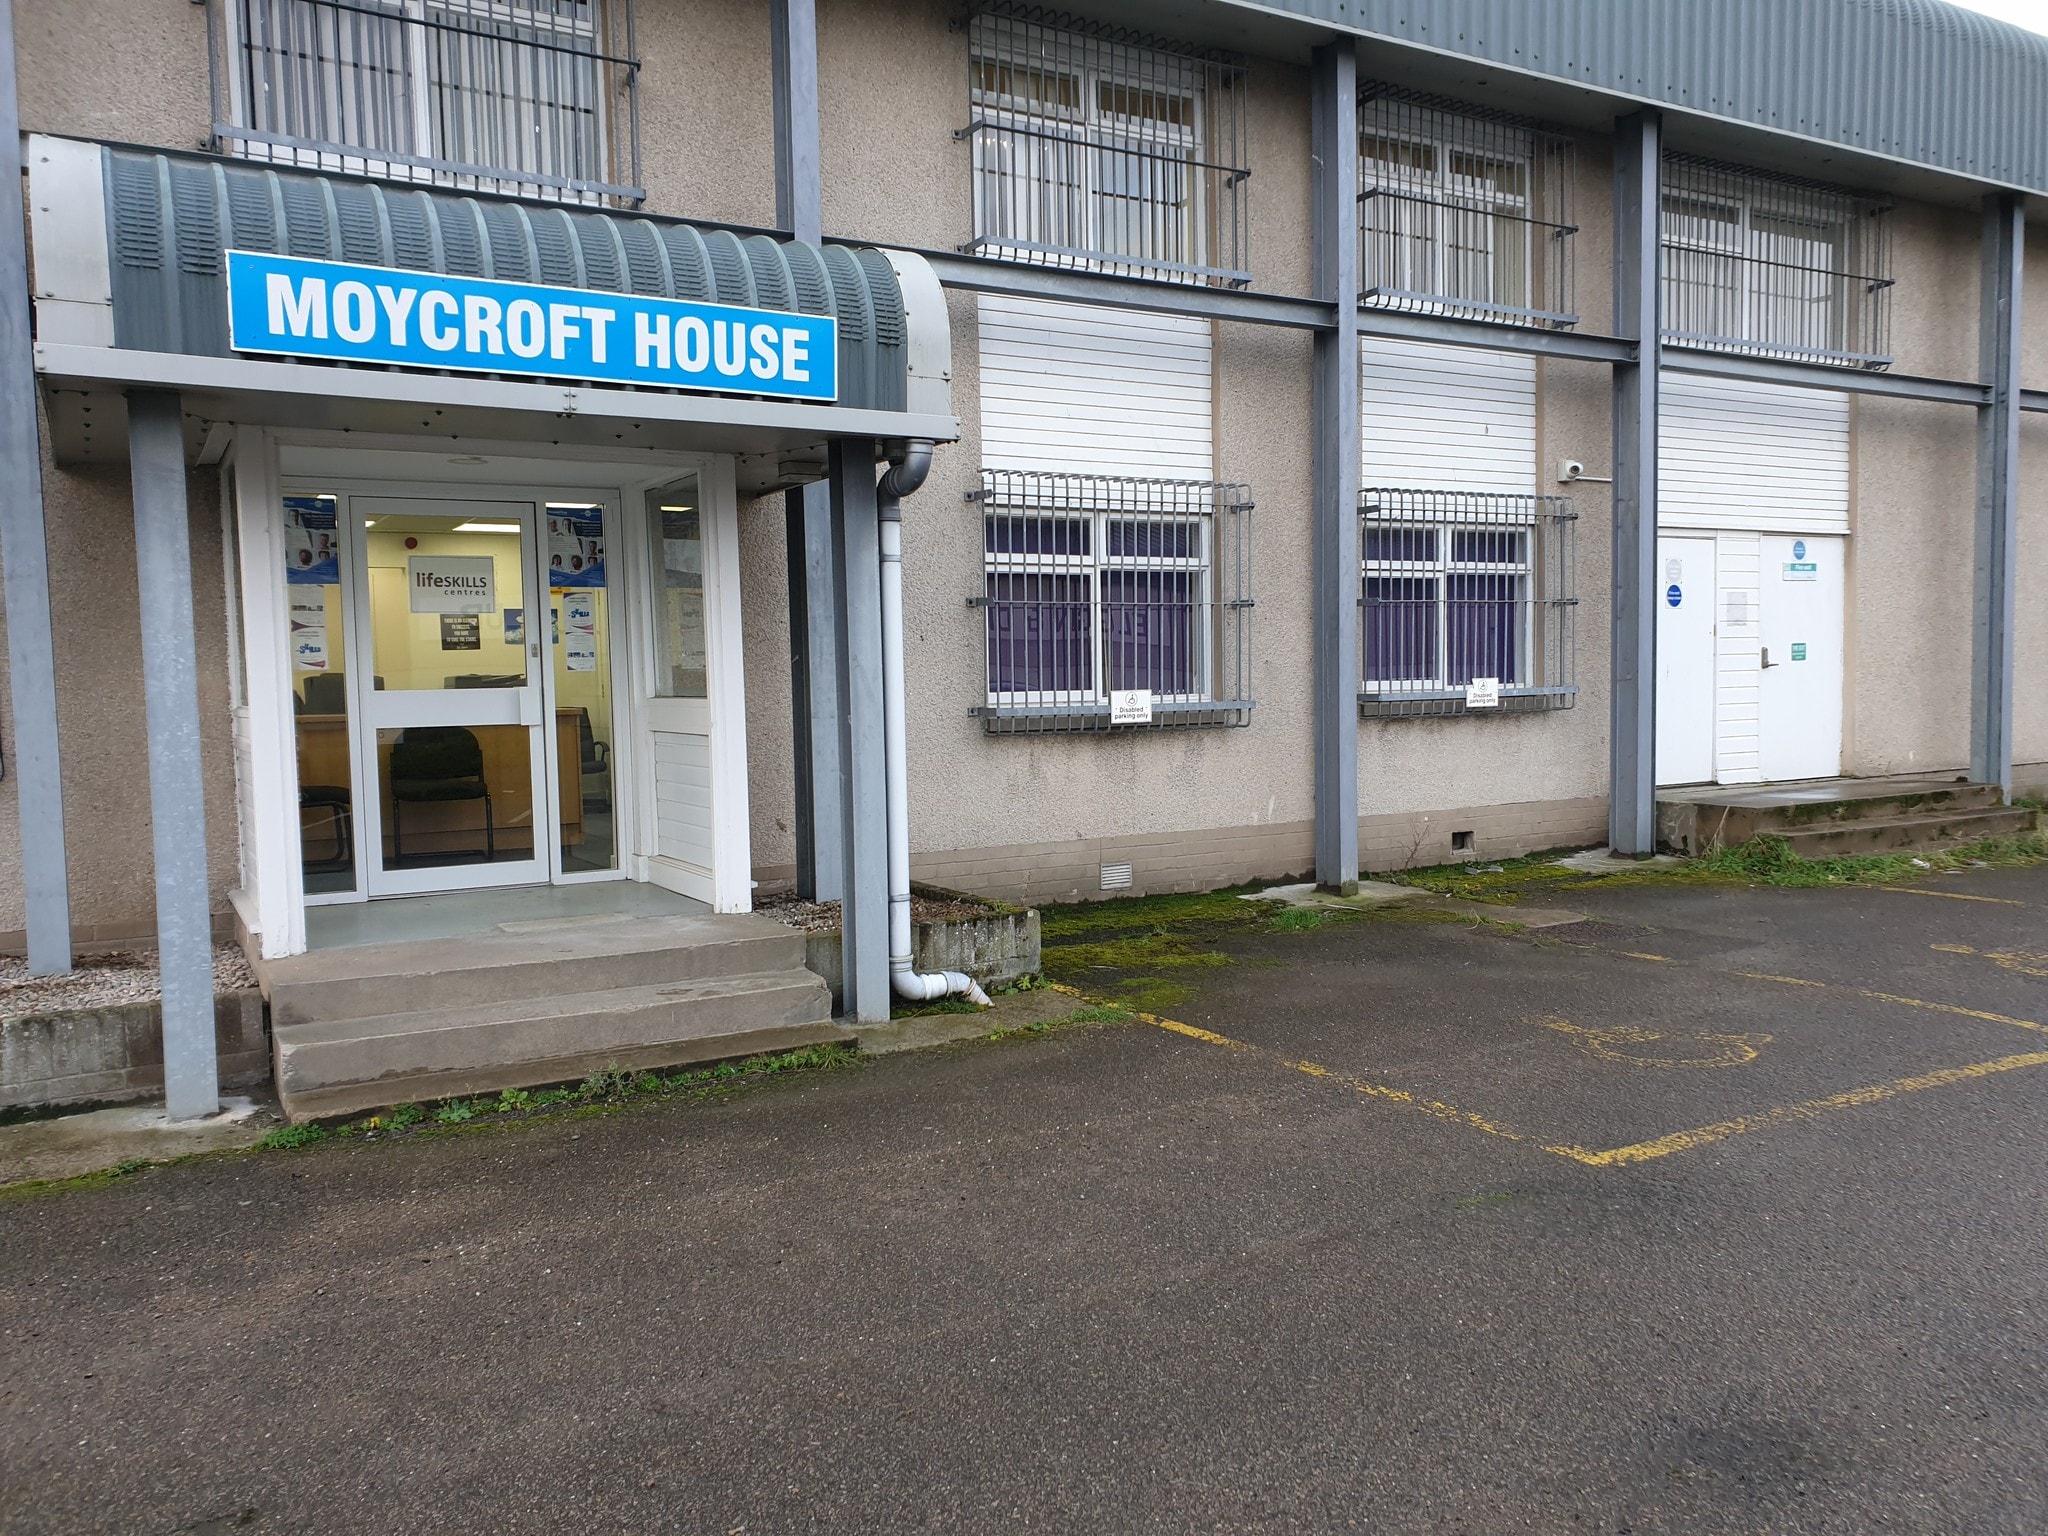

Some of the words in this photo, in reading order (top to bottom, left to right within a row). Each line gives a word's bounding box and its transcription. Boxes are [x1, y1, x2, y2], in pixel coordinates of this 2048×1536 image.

[265, 272, 616, 364] MOYCROFT
[634, 311, 810, 382] HOUSE
[416, 572, 487, 588] lifeSKILLS
